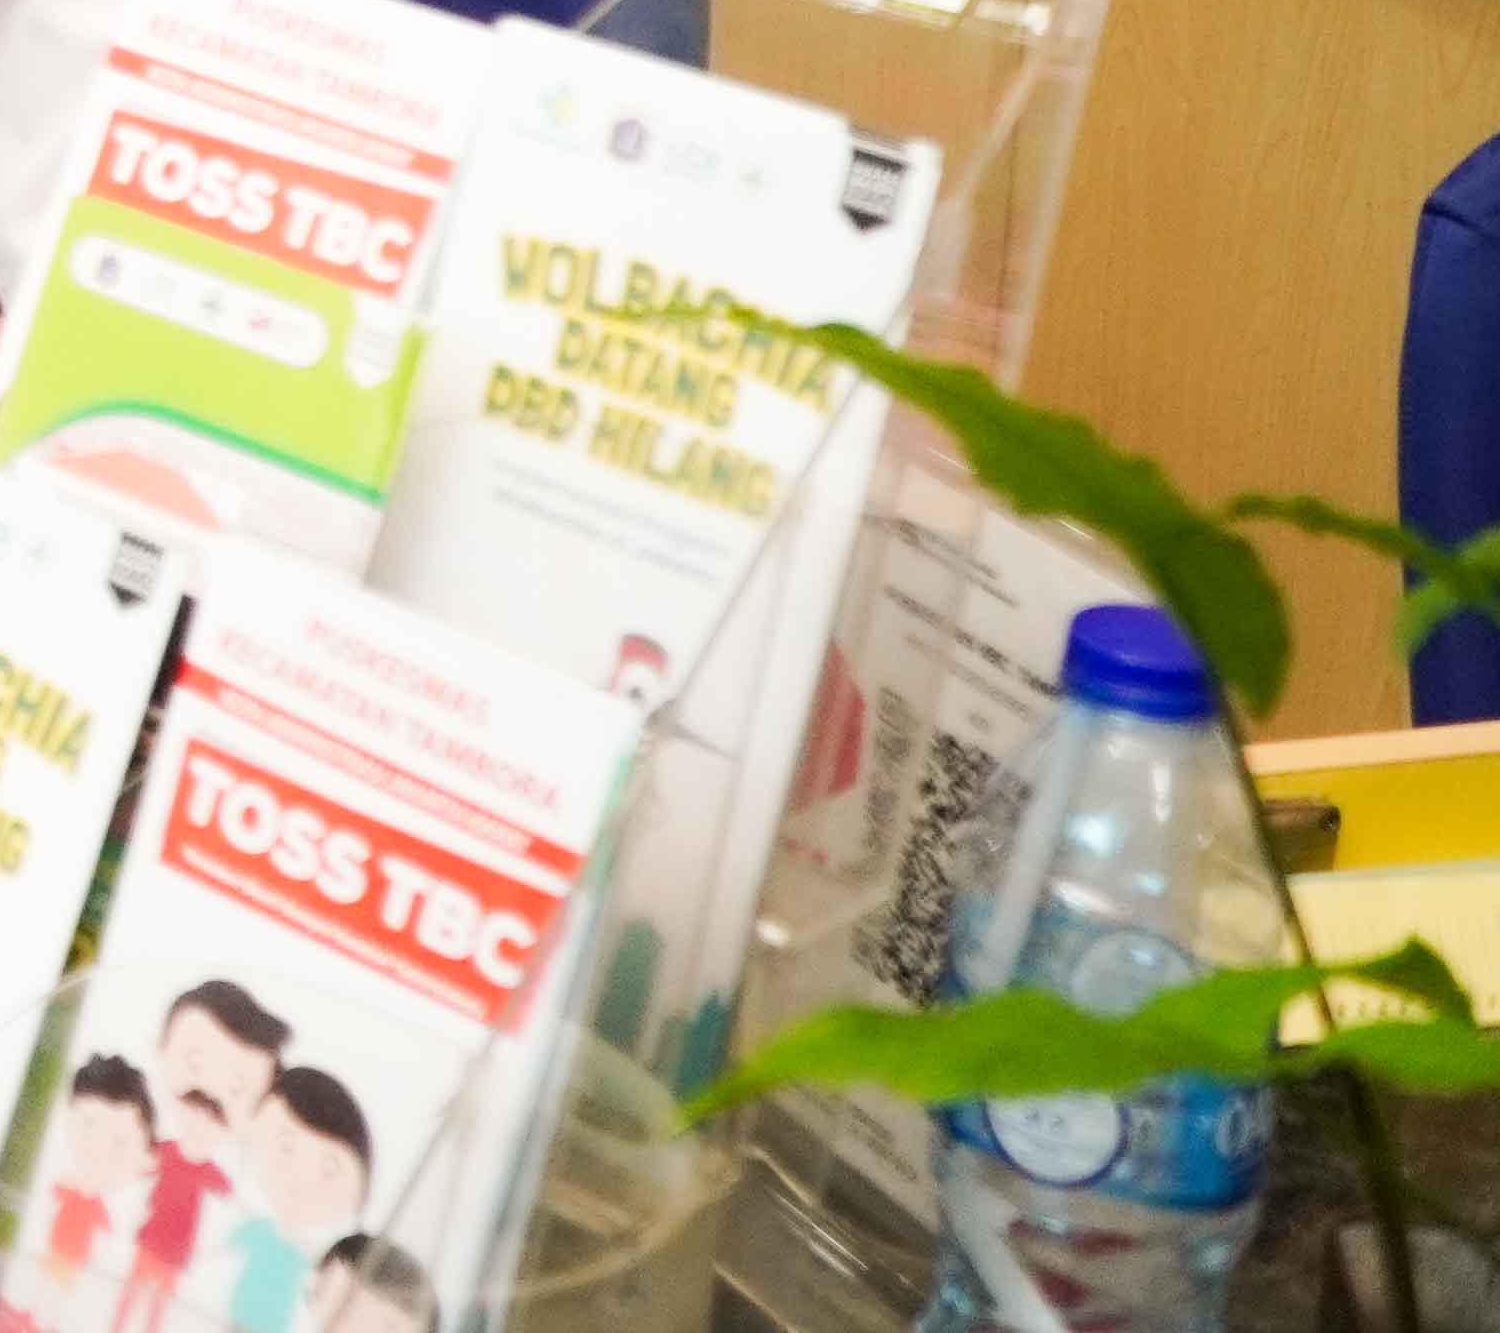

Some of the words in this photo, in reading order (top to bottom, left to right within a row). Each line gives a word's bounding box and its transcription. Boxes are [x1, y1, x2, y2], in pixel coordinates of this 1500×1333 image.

[108, 125, 280, 235] TOSS
[285, 185, 414, 285] TBC
[483, 367, 582, 442] DBD
[588, 402, 779, 521] HILANG
[555, 321, 740, 431] DATANG
[183, 755, 370, 907] TOSS
[375, 852, 542, 990] TBC
